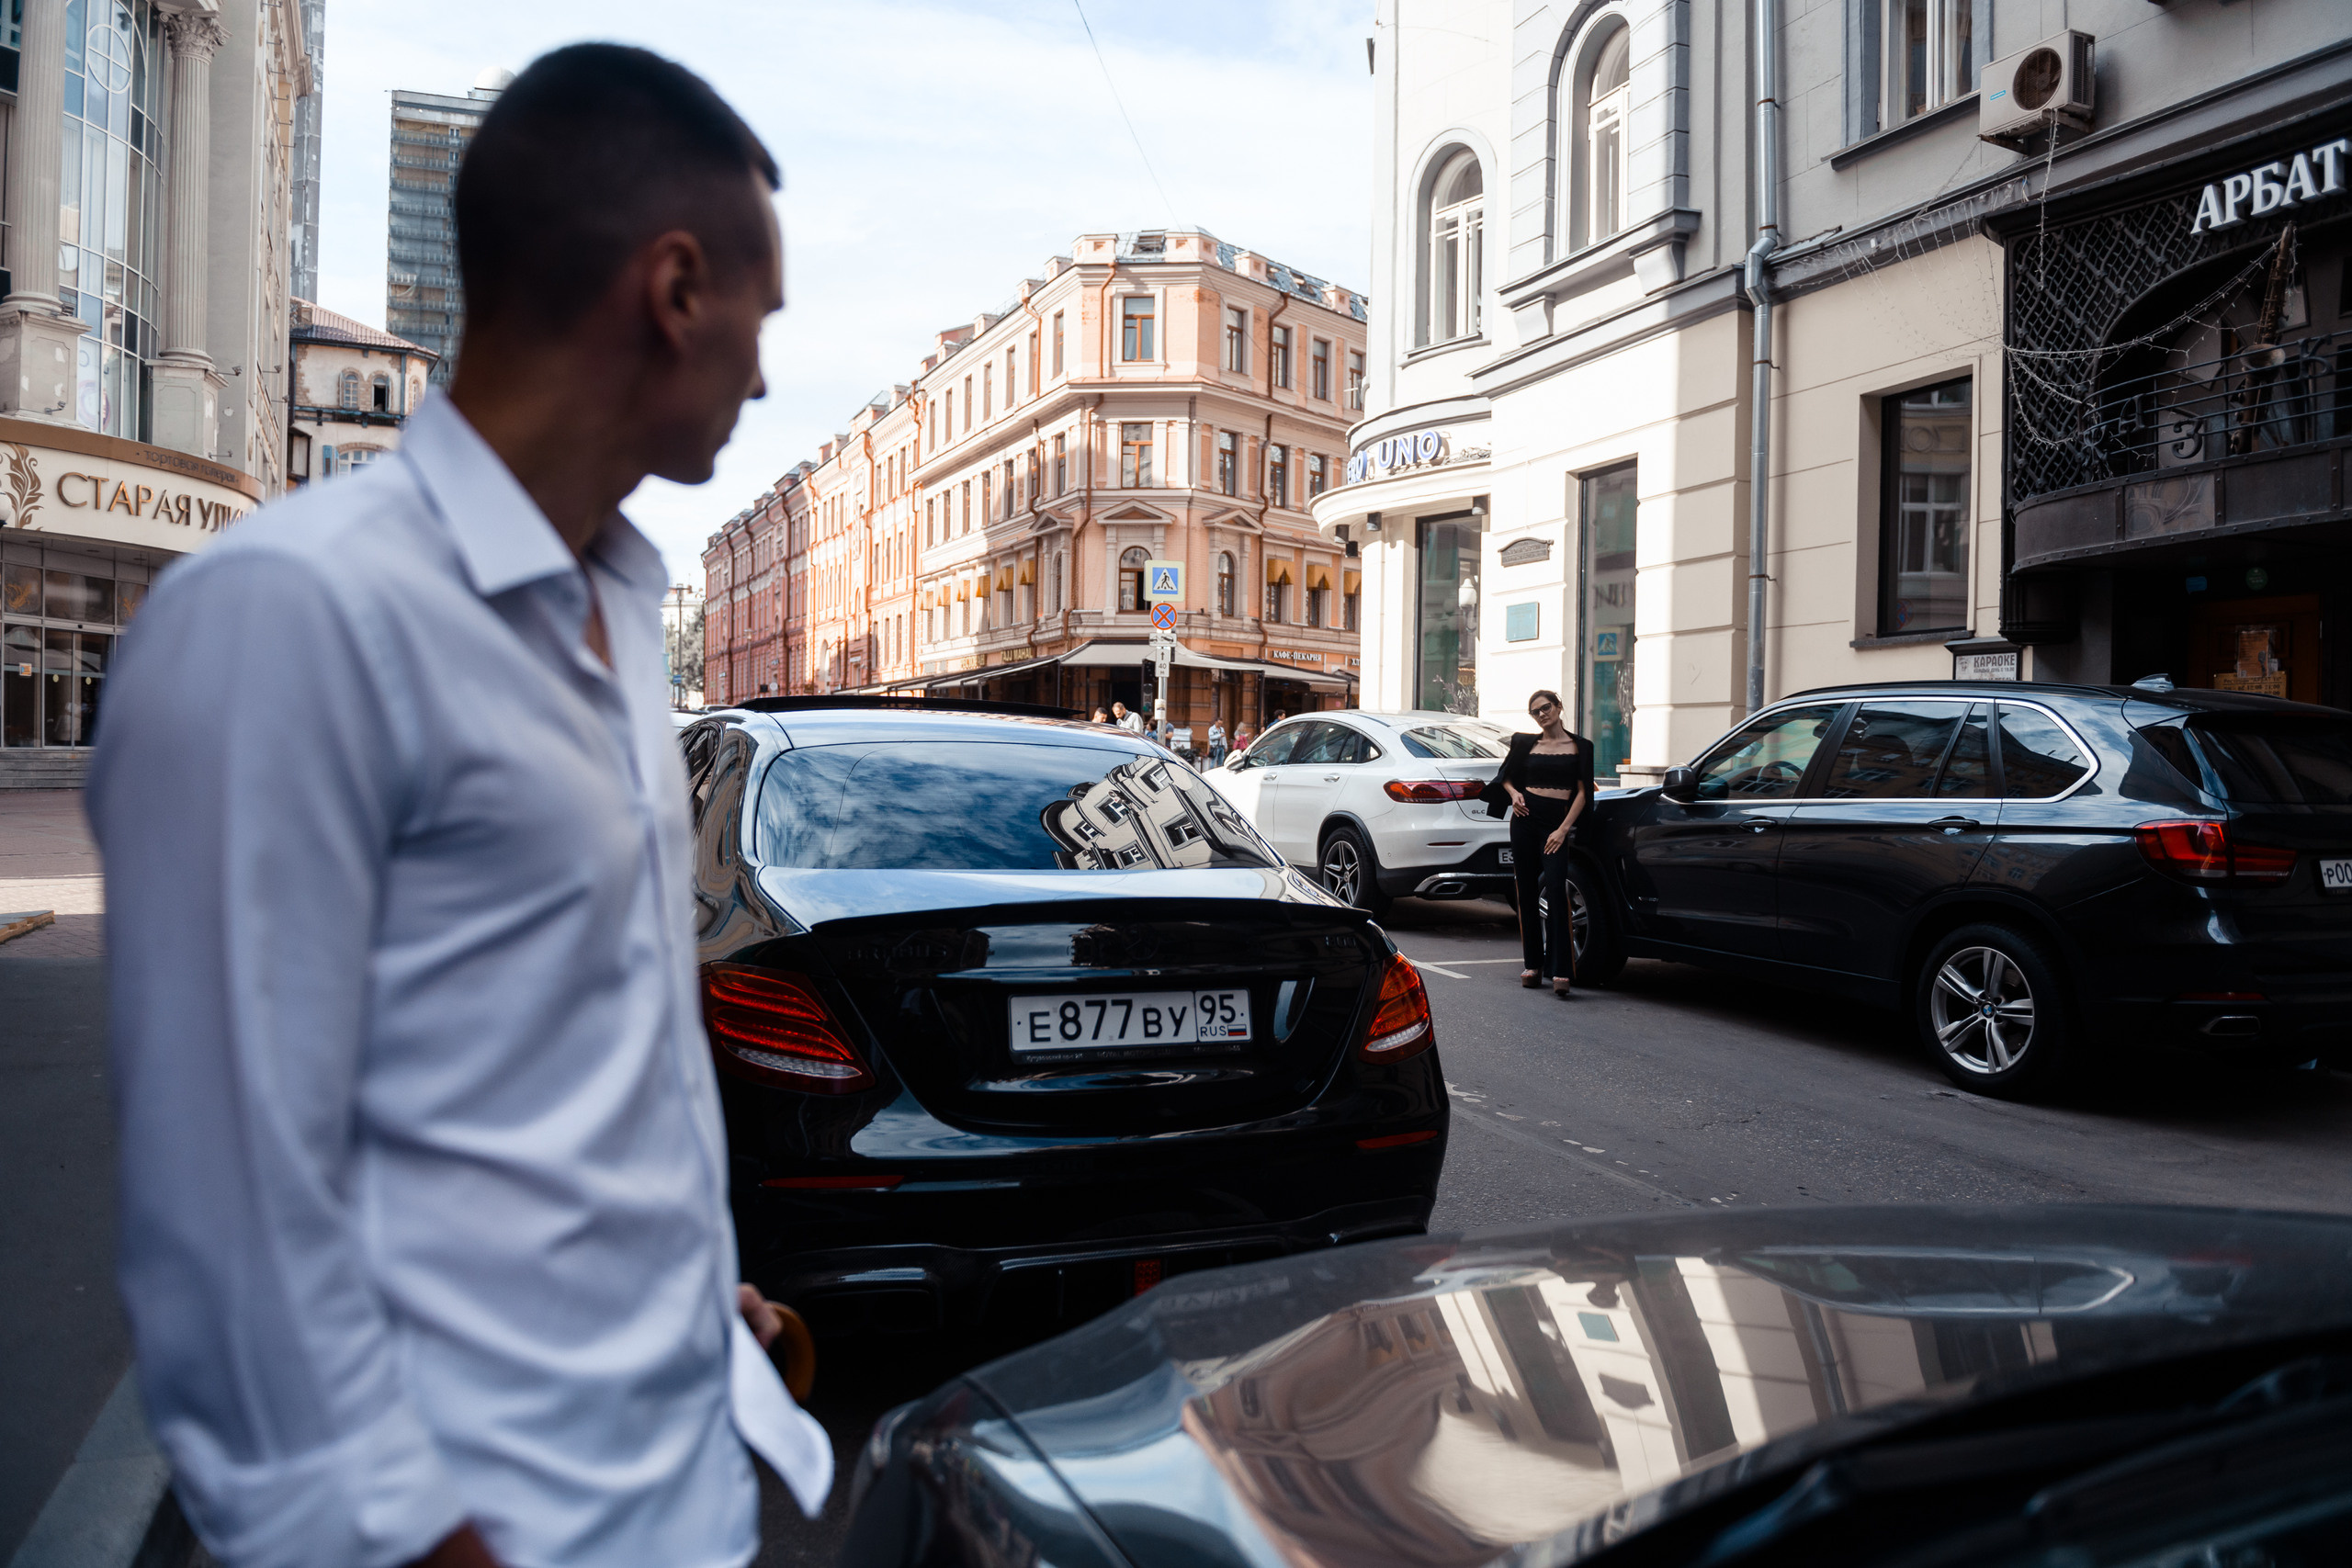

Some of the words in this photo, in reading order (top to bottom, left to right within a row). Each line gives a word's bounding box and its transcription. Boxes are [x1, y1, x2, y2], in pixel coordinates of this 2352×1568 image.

[2190, 139, 2350, 235] АРБАТ
[143, 450, 199, 471] торговая
[1378, 430, 1442, 470] UNO
[57, 472, 191, 526] СТАРАЯ
[198, 498, 250, 533] УЛИ
[1272, 650, 1322, 661] КАФЕ-ПЕКАРНЯ
[1973, 655, 2015, 668] КАРАОКЕ
[1029, 998, 1187, 1043] Е877ВУ
[1199, 994, 1237, 1025] 95
[1200, 1025, 1227, 1037] RUS
